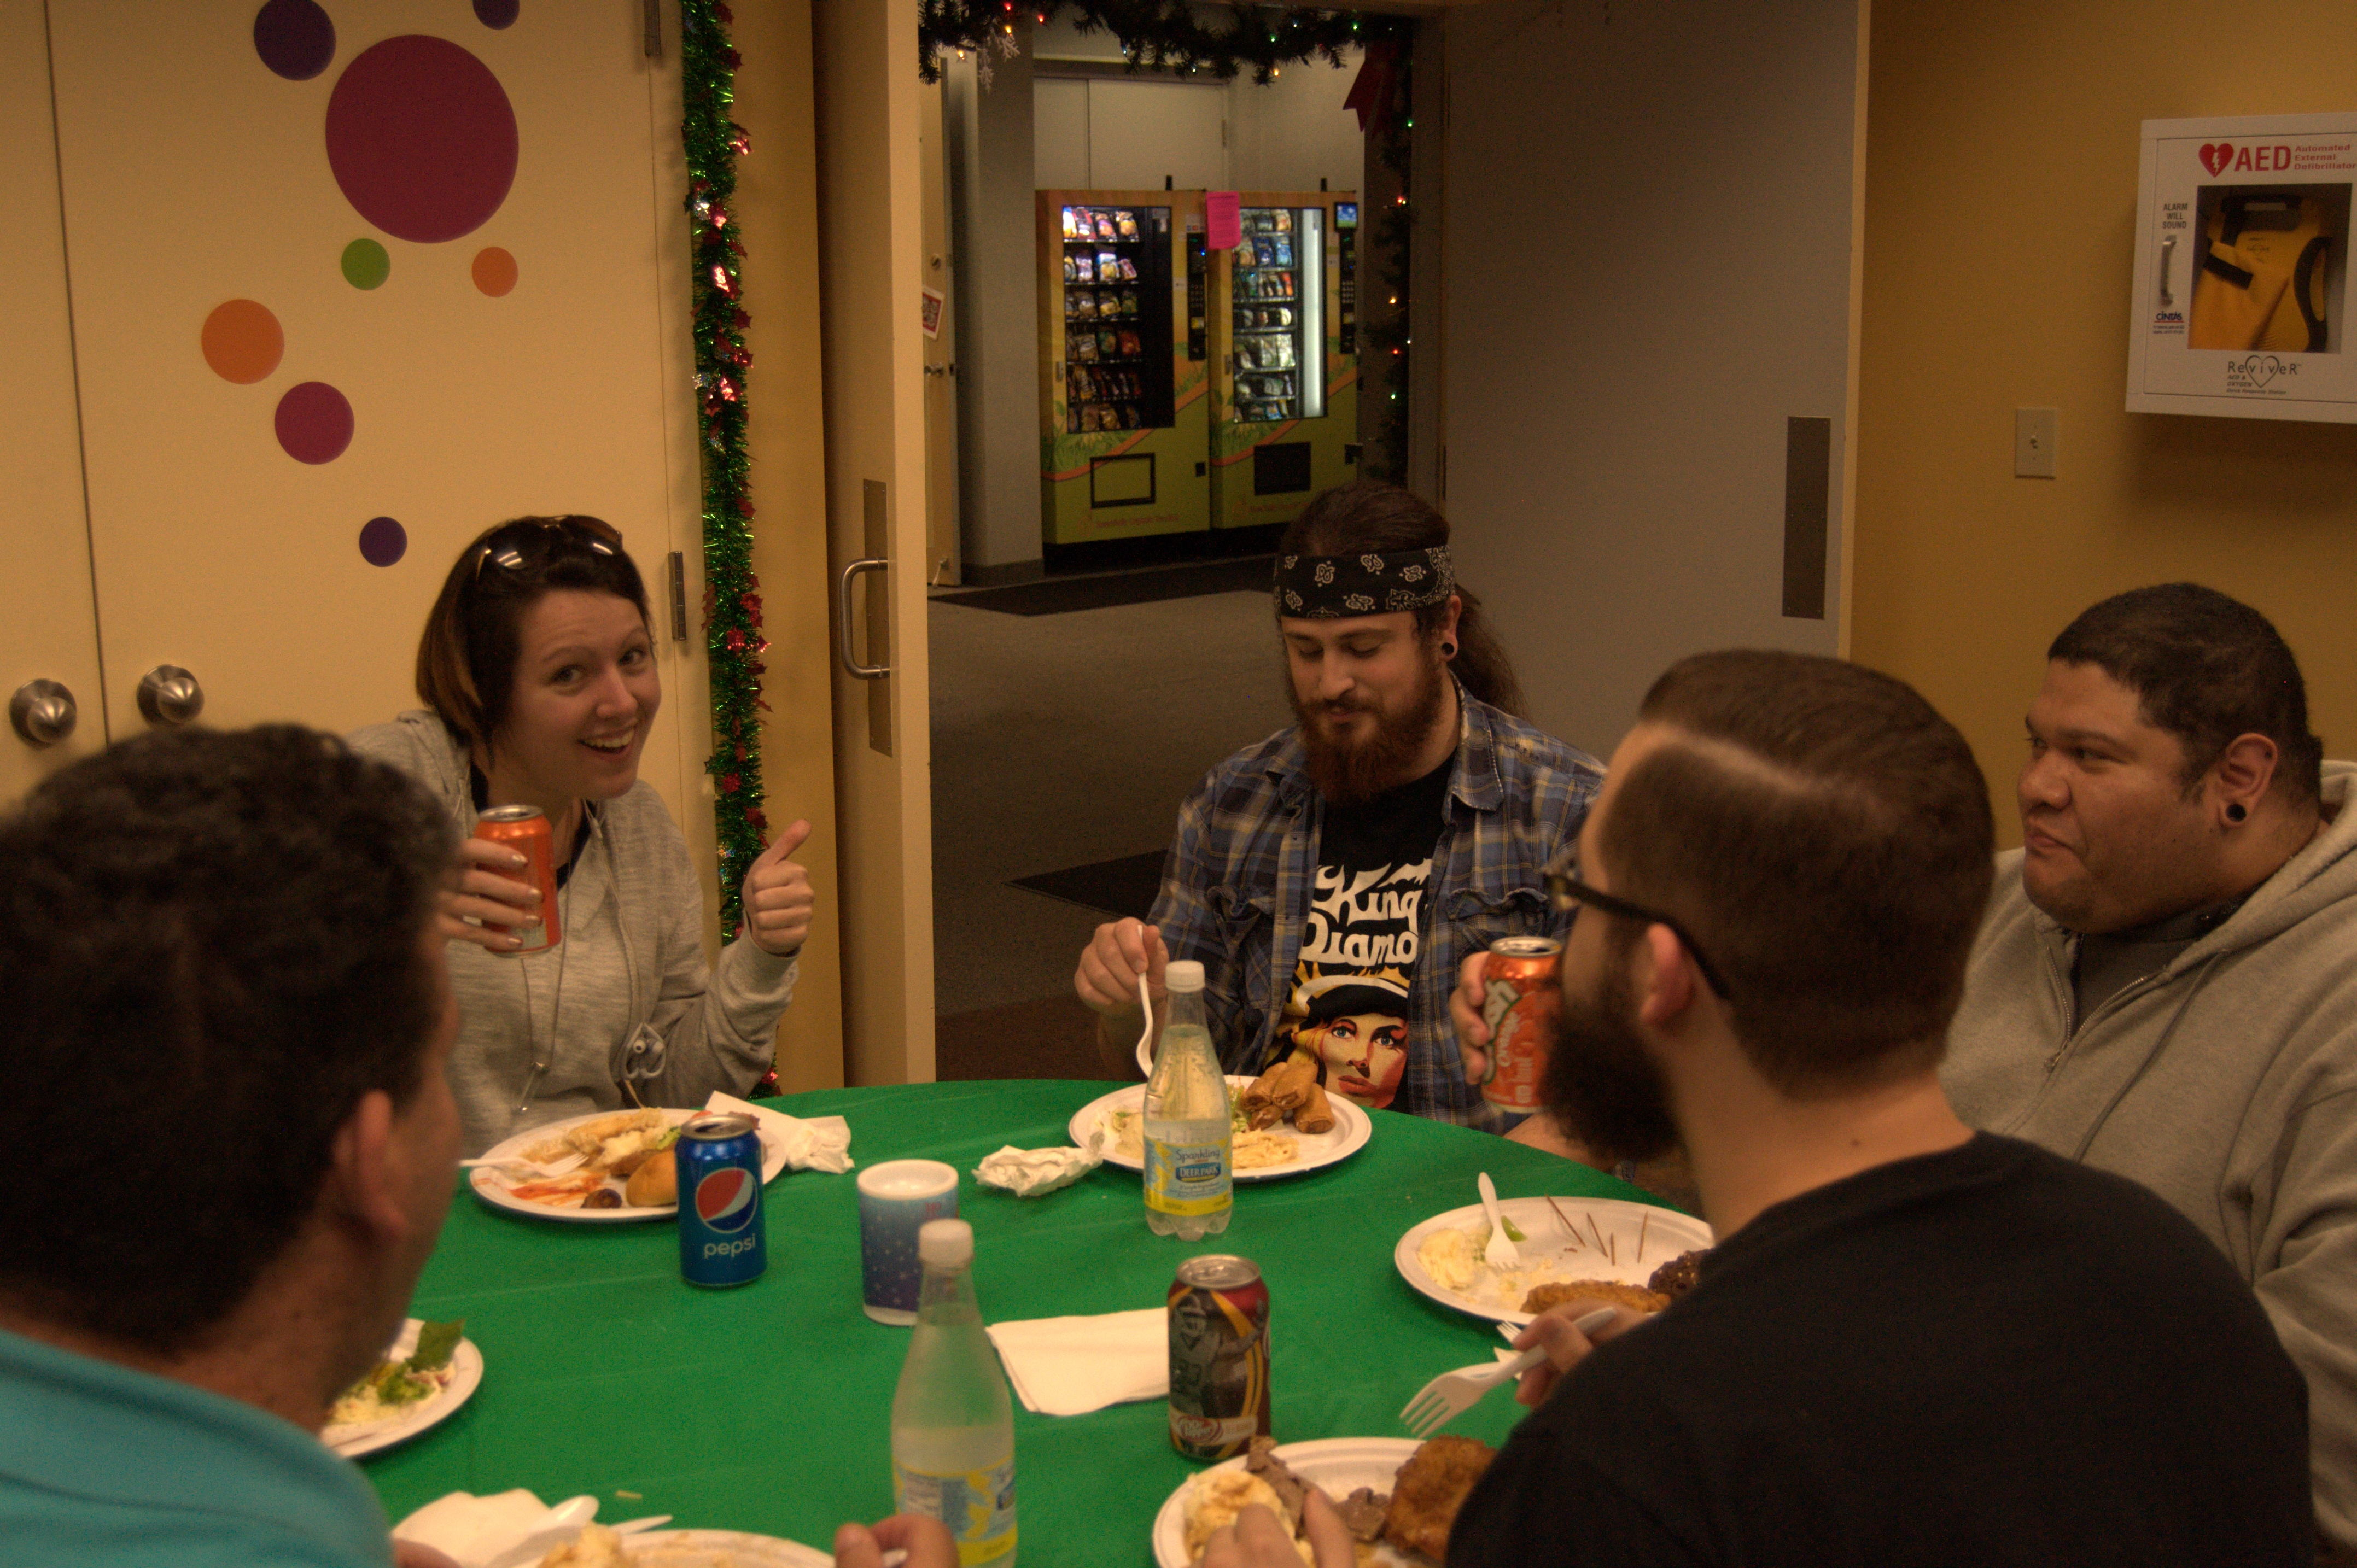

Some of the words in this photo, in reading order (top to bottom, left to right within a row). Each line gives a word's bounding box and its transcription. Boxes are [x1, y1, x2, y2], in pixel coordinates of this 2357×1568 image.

[2295, 144, 2351, 153] Automated
[2235, 145, 2291, 172] AED
[2294, 162, 2356, 171] Defibrillator
[2163, 203, 2188, 211] ALARM
[1311, 862, 1423, 936] King
[1297, 910, 1419, 967] Diamo
[1176, 1148, 1220, 1164] Sparkling
[1180, 1167, 1200, 1177] DEER
[1200, 1166, 1218, 1175] PARK
[704, 1232, 756, 1259] pepsi
